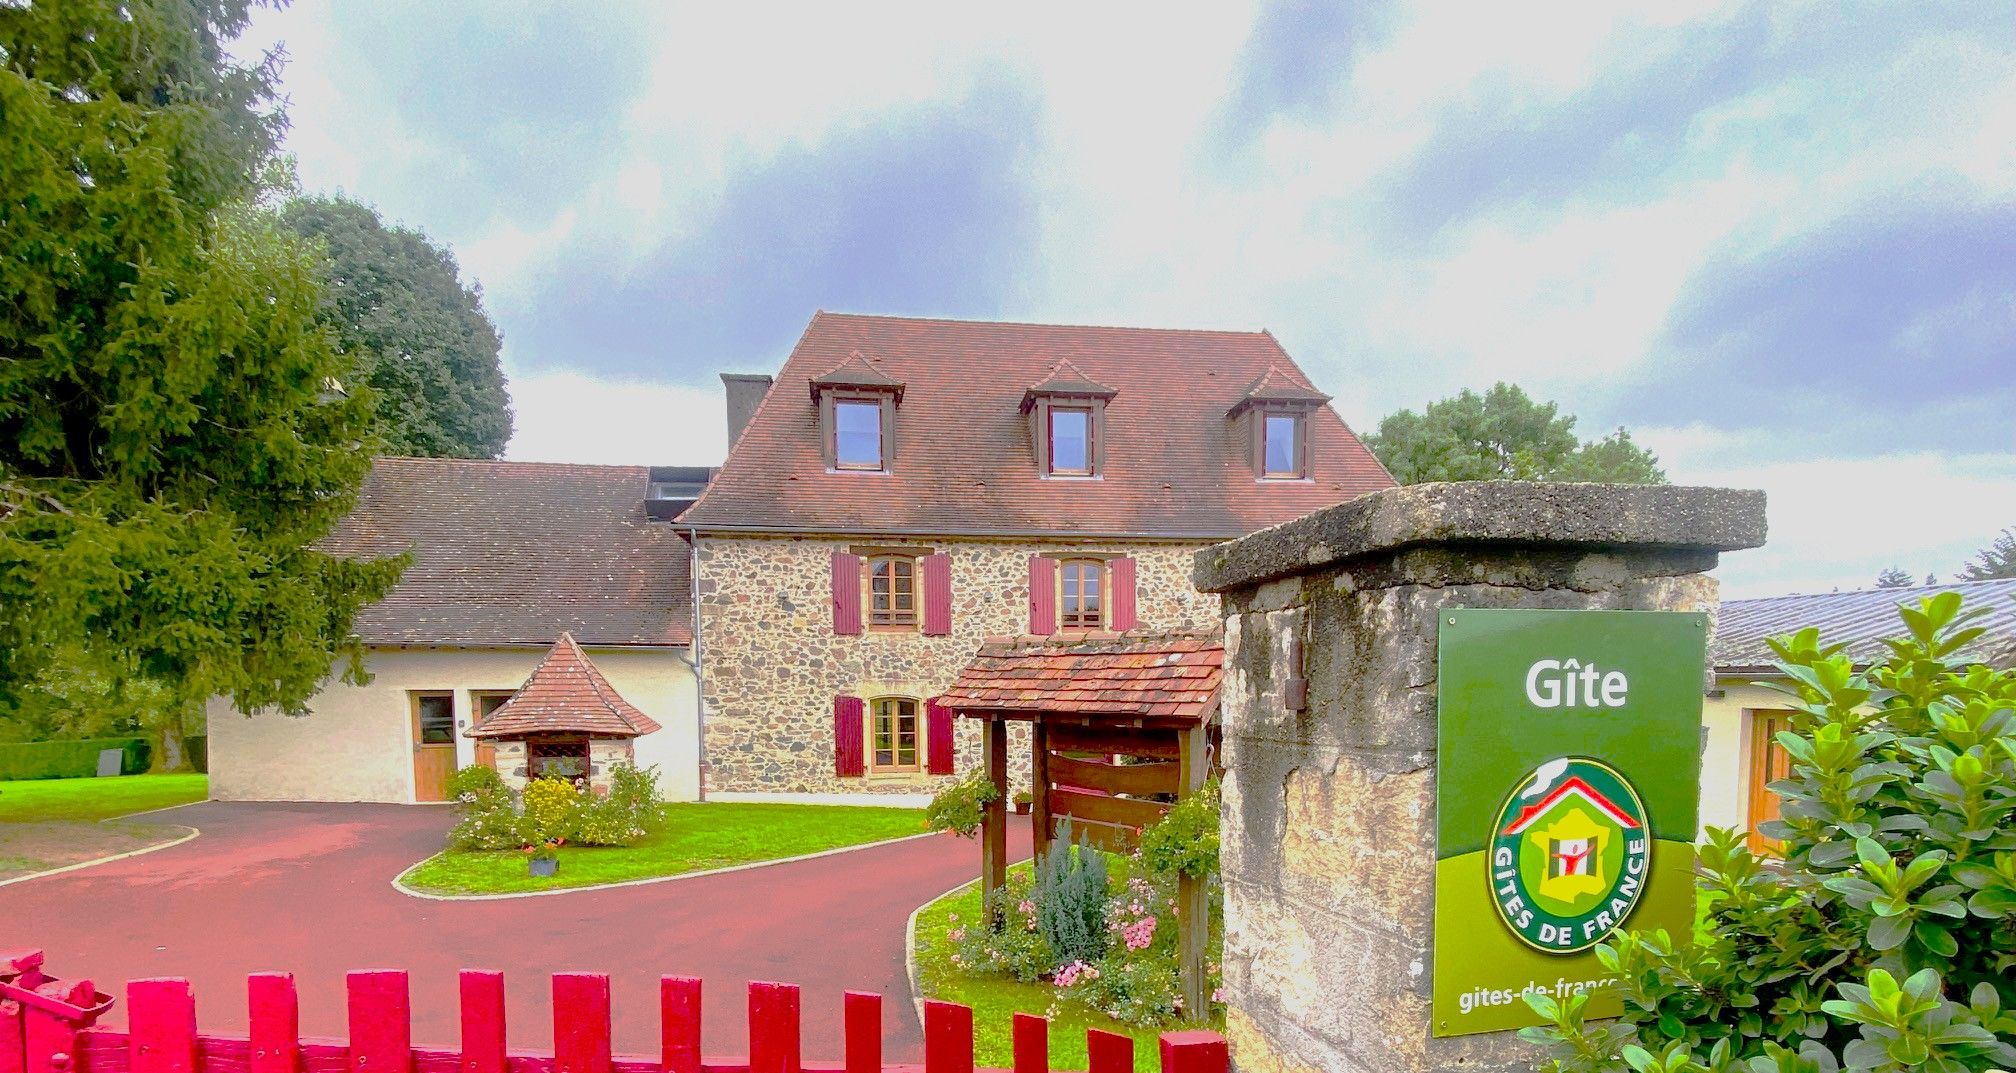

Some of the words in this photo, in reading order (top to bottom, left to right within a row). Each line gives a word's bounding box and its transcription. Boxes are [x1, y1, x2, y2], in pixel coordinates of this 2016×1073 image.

[1525, 658, 1628, 708] Gîte
[1538, 923, 1572, 946] DE
[1582, 838, 1644, 940] FRANCE
